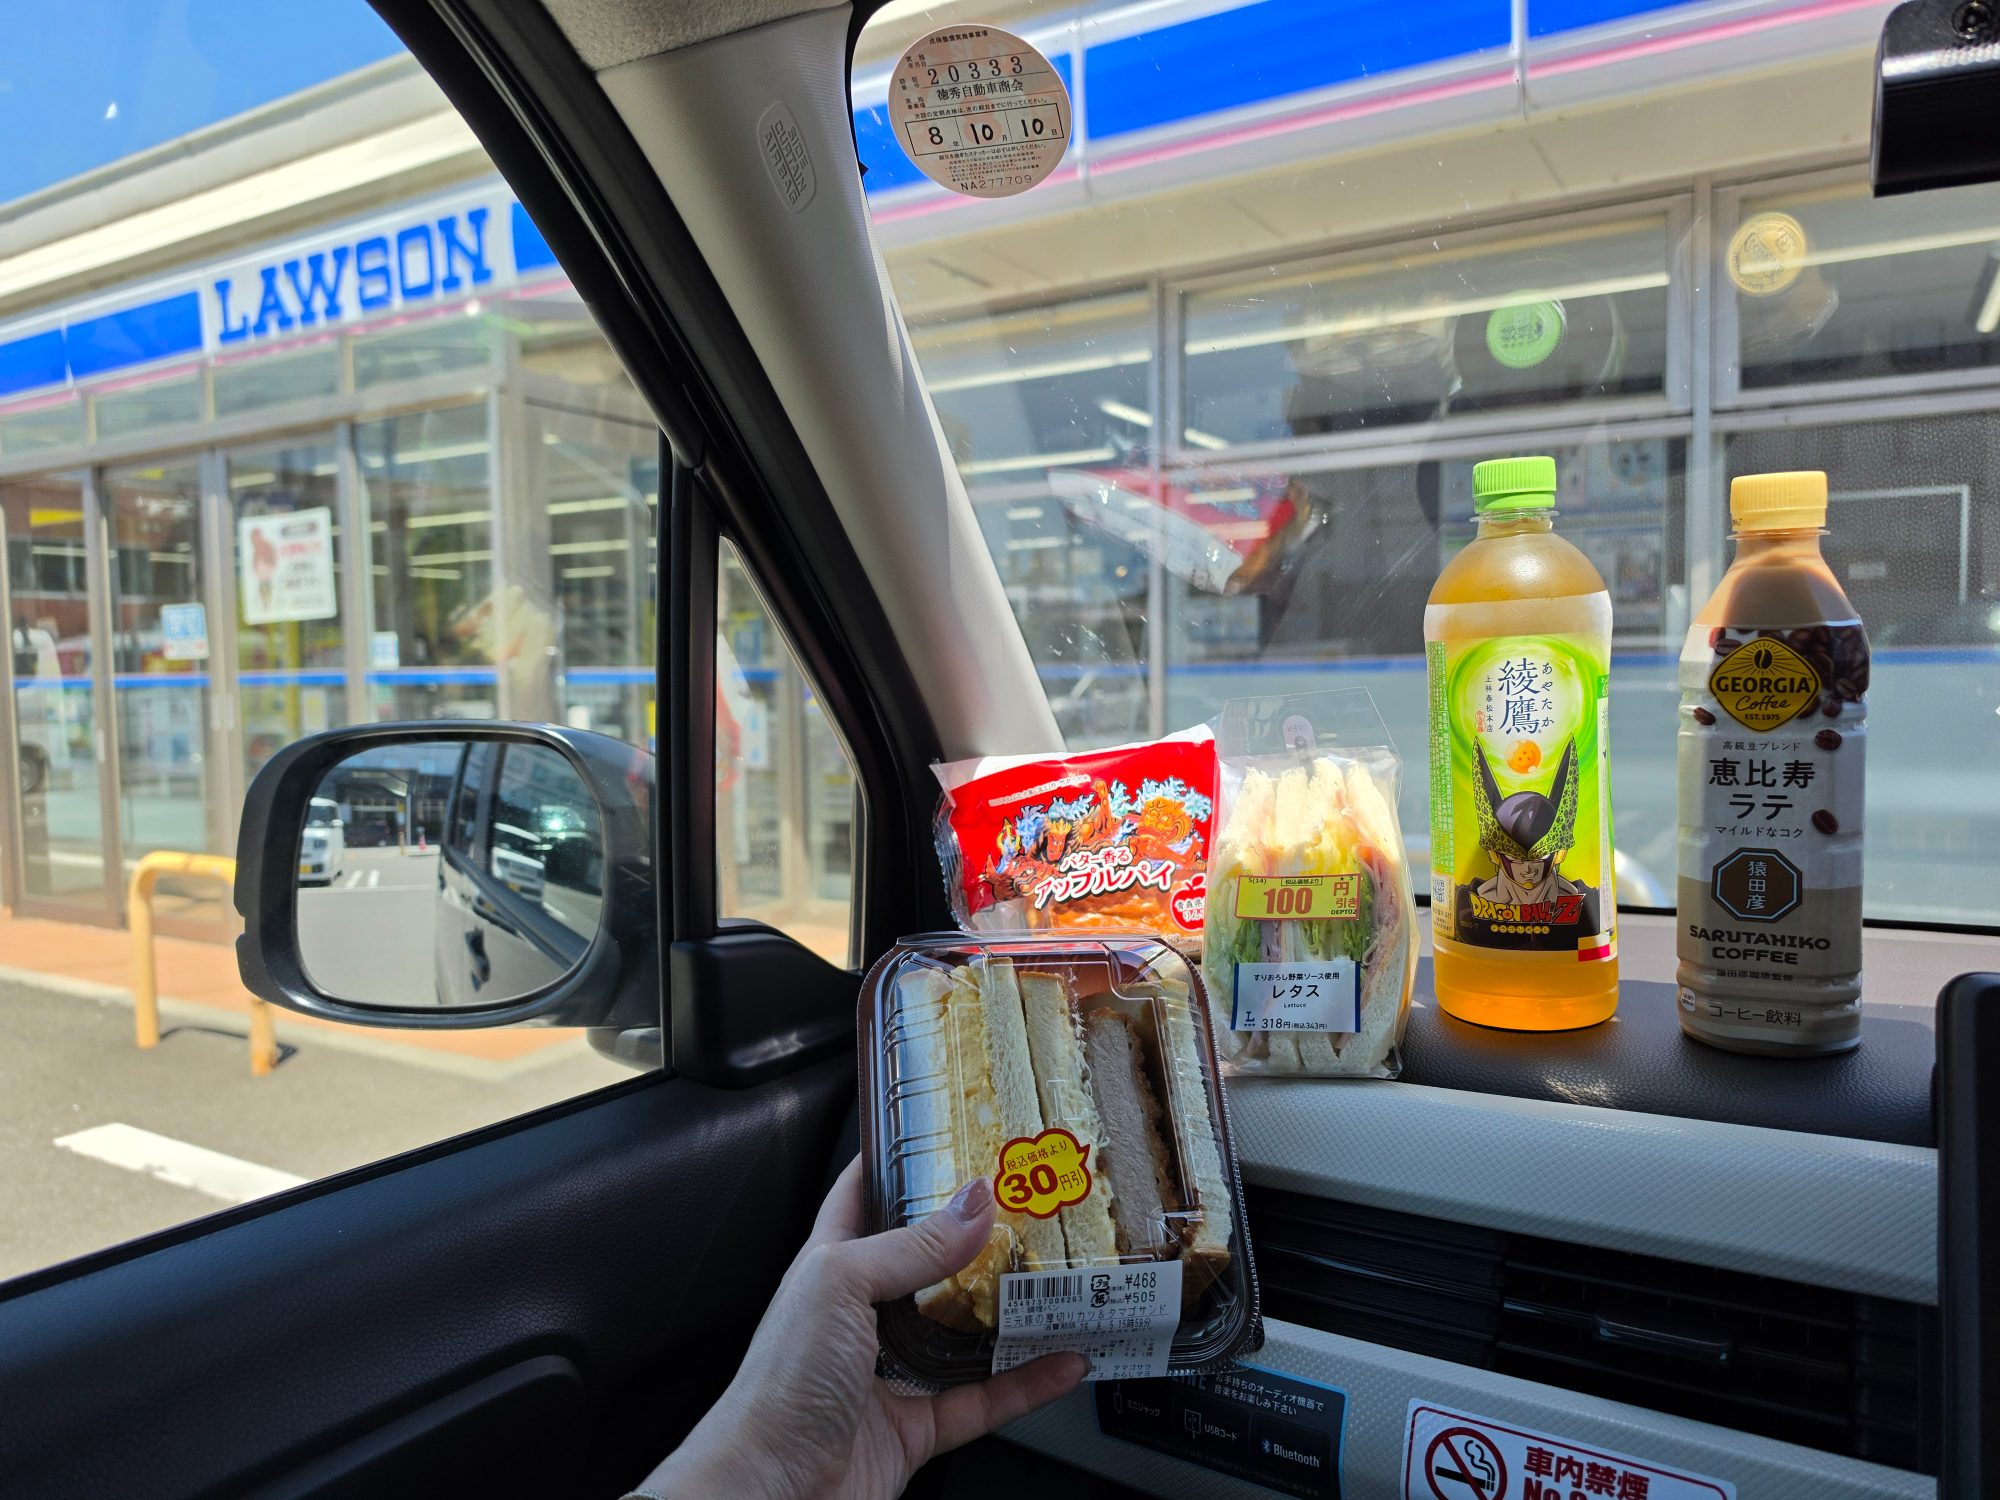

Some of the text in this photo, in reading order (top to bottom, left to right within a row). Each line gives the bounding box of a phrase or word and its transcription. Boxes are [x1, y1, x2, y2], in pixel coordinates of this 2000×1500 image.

[927, 55, 1023, 86] 20333
[937, 78, 1024, 101] 徳秀自動車商会
[928, 126, 944, 145] 8
[970, 123, 994, 145] 10
[1021, 118, 1044, 137] 10
[774, 119, 807, 193] CURTAIN
[788, 126, 809, 170] SIDE
[764, 131, 798, 205] AIRBAG
[960, 174, 1033, 191] NA277709
[214, 207, 494, 345] LAWSON
[1498, 657, 1541, 734] 綾鷹
[1541, 662, 1555, 728] あやたか
[1716, 676, 1811, 694] GEORGIA
[1735, 695, 1791, 712] Coffee
[1722, 740, 1802, 752] 高級豆ブレンド
[1709, 758, 1815, 789] 恵比寿
[1728, 793, 1793, 821] ラテ
[1714, 825, 1803, 839] マイルドなコク
[1062, 848, 1132, 872] バター香る
[1036, 864, 1173, 907] アップルパイ
[1746, 860, 1767, 910] 猿田彦
[1263, 886, 1312, 915] 100
[1689, 925, 1831, 950] SARUTAHIKO
[1711, 946, 1798, 965] COFFEE
[1253, 972, 1340, 983] すりおろし野菜ソース使用
[1272, 984, 1320, 998] レタス
[1709, 1004, 1802, 1026] コーヒー飲料
[1006, 1140, 1068, 1172] 税込価格より
[1003, 1164, 1084, 1204] 30 円引
[1125, 1273, 1156, 1290] ¥468
[1124, 1291, 1155, 1304] ¥505
[1214, 1385, 1297, 1416] 音楽をお楽しみ下さい
[1215, 1374, 1325, 1411] お手持ちのオーディオ機器で
[1204, 1424, 1238, 1441] USBコード
[1273, 1443, 1321, 1468] Bluetooth
[1524, 1446, 1649, 1500] 車内禁煙
